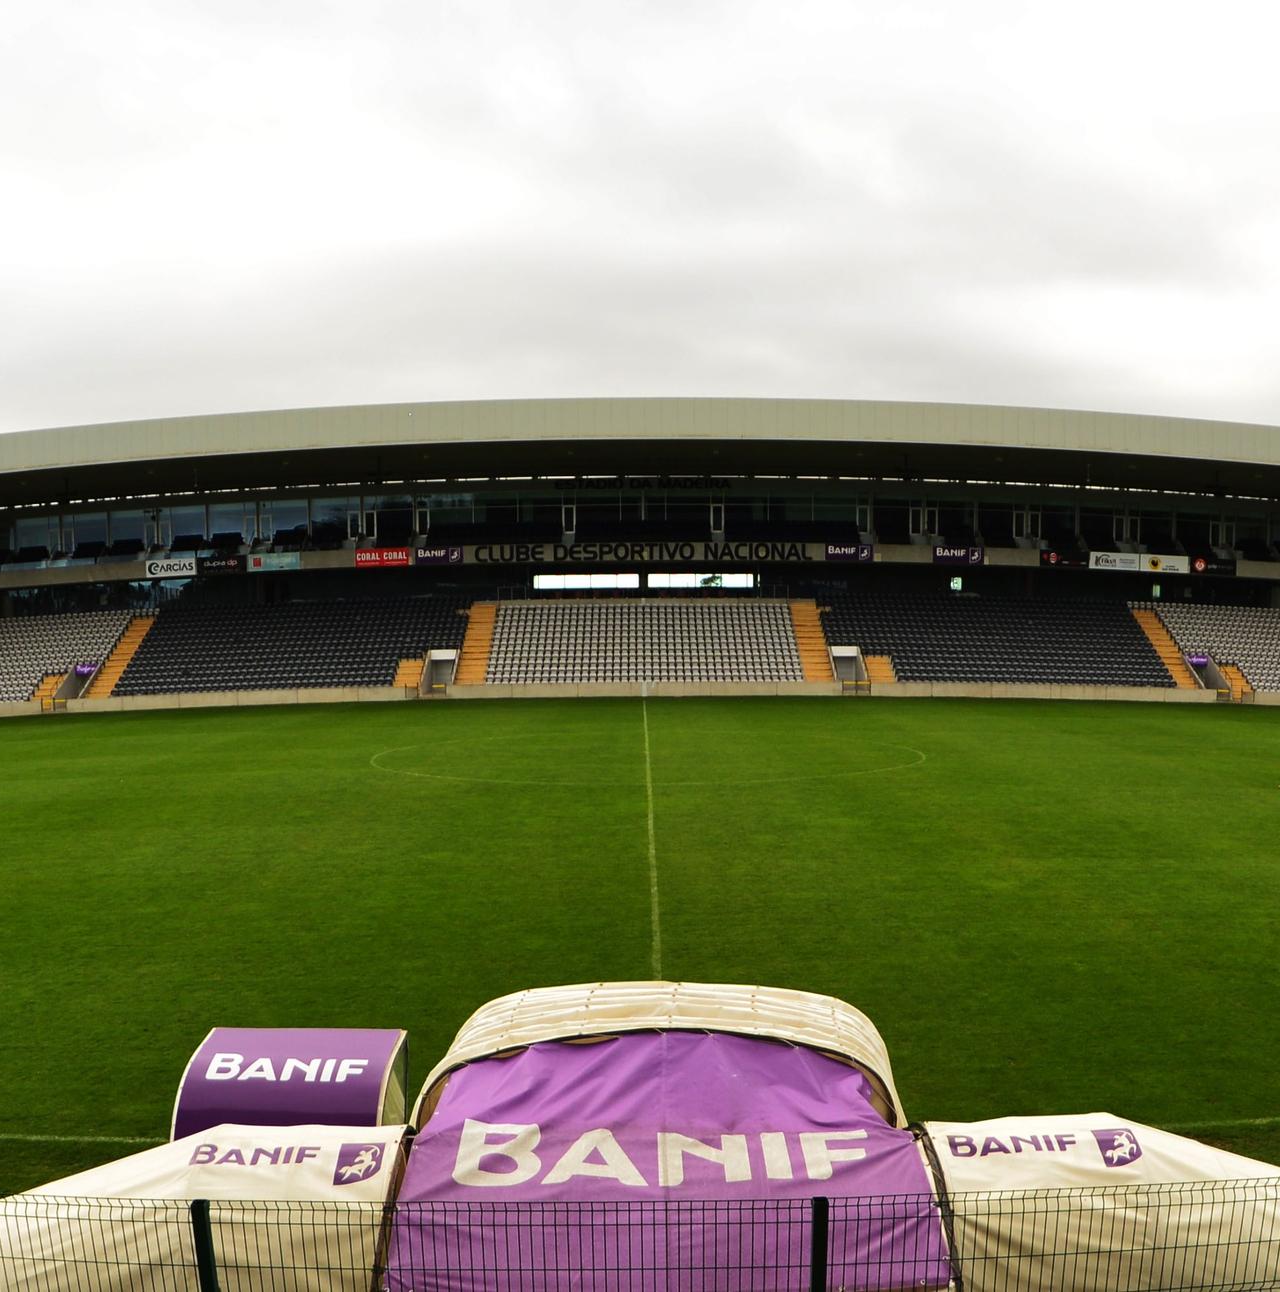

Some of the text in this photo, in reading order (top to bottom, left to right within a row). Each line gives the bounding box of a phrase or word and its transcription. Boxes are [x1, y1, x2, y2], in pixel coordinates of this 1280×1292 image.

[356, 551, 407, 561] CORAL CORAL
[417, 549, 447, 558] BANIF
[474, 543, 812, 563] CLUBE DESPORTIVO NACIONAL
[828, 545, 856, 555] BANIF
[936, 547, 967, 558] BANIF
[205, 1053, 369, 1082] BANIF
[189, 1144, 321, 1166] BANIF
[451, 1118, 867, 1187] BANIF
[946, 1134, 1076, 1157] BANIF
